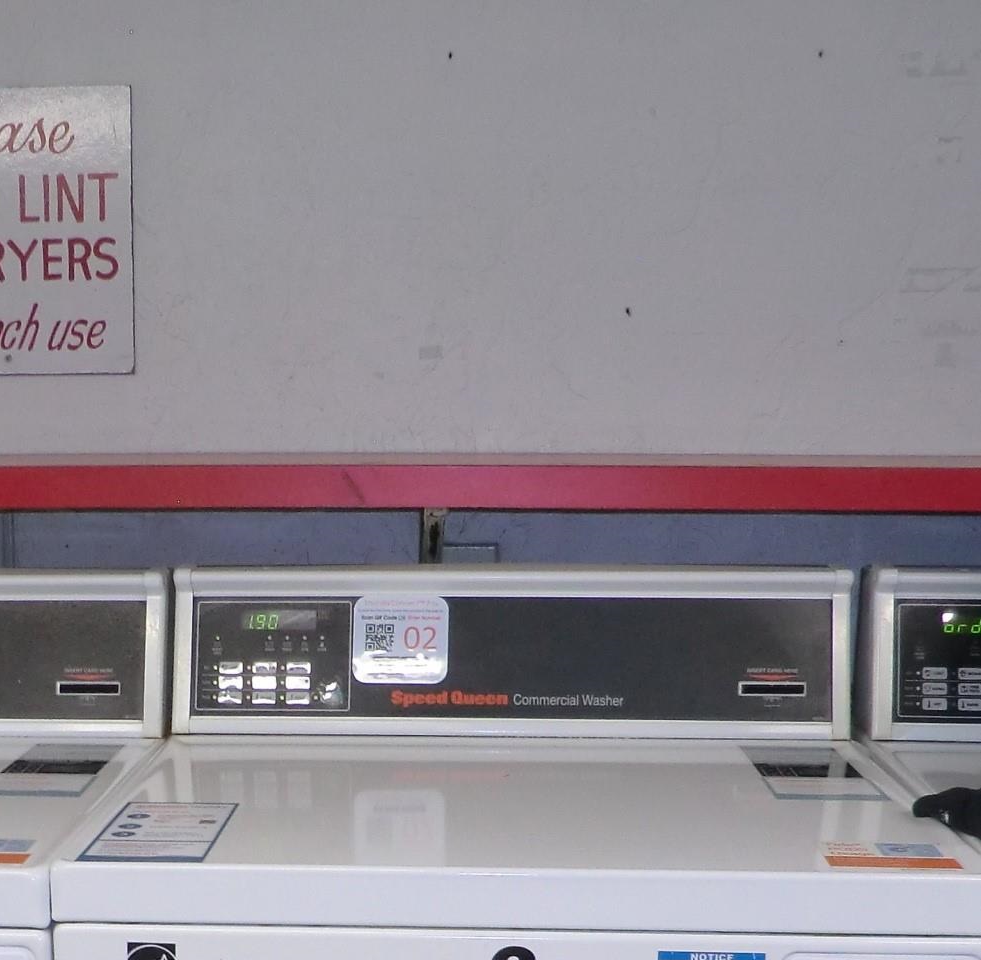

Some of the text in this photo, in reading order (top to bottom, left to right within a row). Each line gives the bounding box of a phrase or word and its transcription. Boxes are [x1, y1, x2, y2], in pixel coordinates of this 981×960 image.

[19, 172, 119, 223] LINT
[47, 318, 107, 351] use
[404, 626, 437, 650] 02
[391, 690, 624, 707] Speed Queen Commercial Washer
